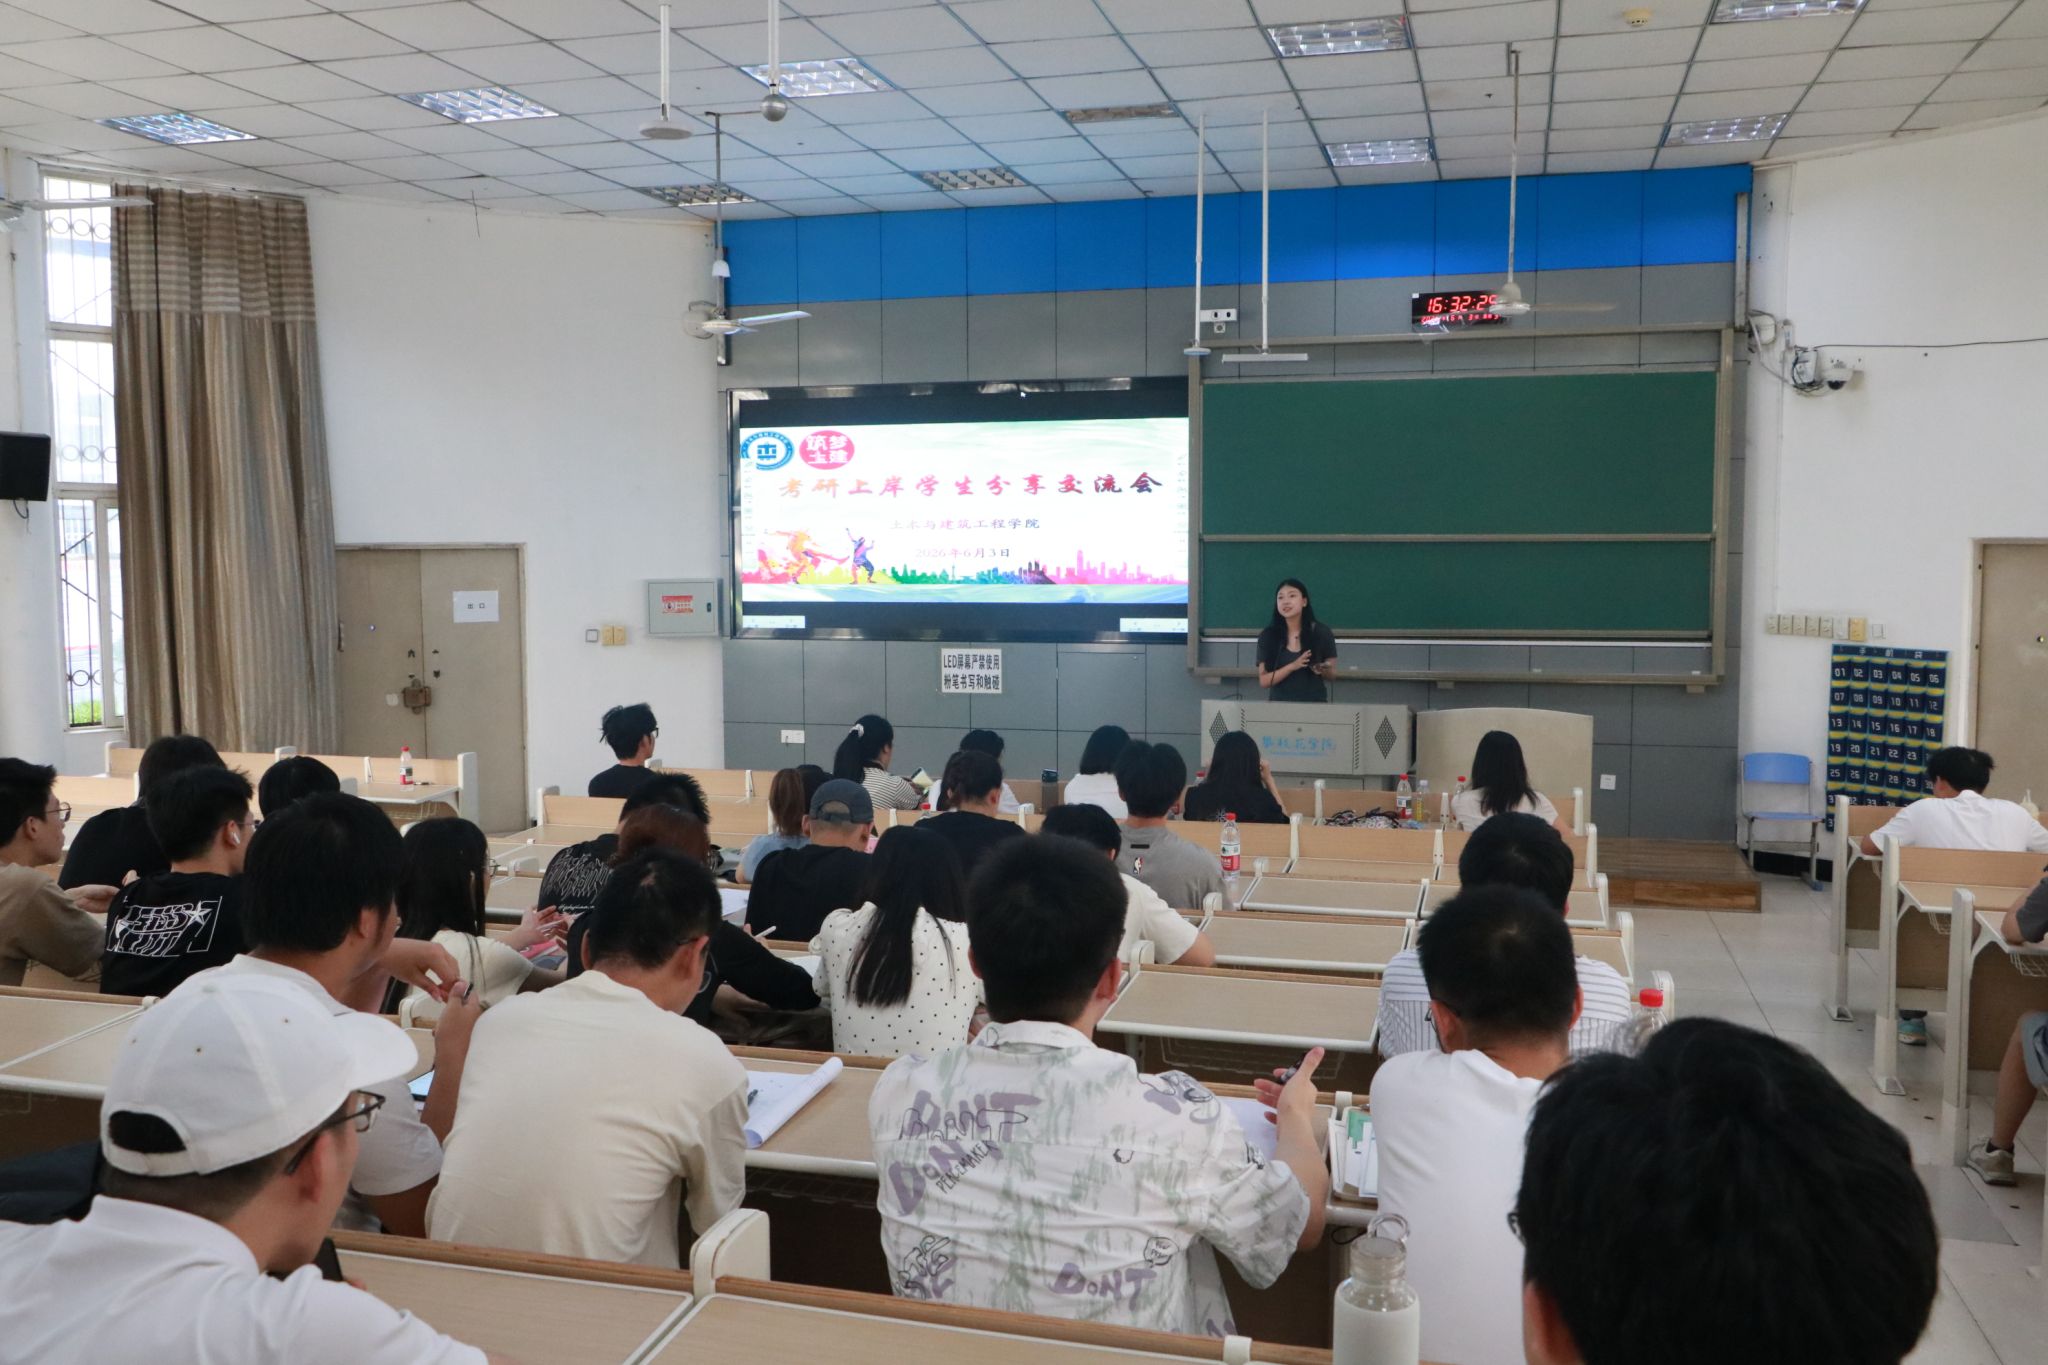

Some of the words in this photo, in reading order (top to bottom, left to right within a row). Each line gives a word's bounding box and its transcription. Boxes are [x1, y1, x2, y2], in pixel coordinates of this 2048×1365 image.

[779, 472, 1162, 499] 考研上岸学生分享交流会
[890, 518, 1040, 530] 土木与建筑工程学院
[915, 548, 1010, 558] 2026年6月3日
[943, 654, 1000, 670] LED屏幕严禁使用
[943, 673, 1000, 690] 粉笔书写和触碰
[1835, 668, 1846, 677] 01
[1854, 669, 1863, 677] 02
[1874, 670, 1883, 679] 03
[1892, 671, 1902, 680] 04
[1911, 673, 1920, 682] 05
[1929, 674, 1939, 683] 06
[1834, 693, 1845, 701] 07
[1854, 694, 1863, 702] 08
[1873, 696, 1882, 704] 09
[1891, 697, 1901, 706] 10
[1910, 699, 1919, 708] 11
[1929, 701, 1938, 710] 12
[1832, 718, 1842, 728] 13
[1853, 720, 1862, 729] 14
[1872, 722, 1881, 731] 15
[1890, 723, 1900, 733] 16
[1908, 725, 1917, 735] 17
[1927, 728, 1936, 737] 18
[1831, 744, 1841, 752] 19
[1850, 744, 1860, 753] 20
[1871, 747, 1880, 756] 21
[1889, 749, 1899, 758] 22
[1907, 751, 1917, 760] 23
[1830, 769, 1840, 778] 25
[1850, 770, 1860, 779] 26
[1869, 772, 1879, 781] 27
[1889, 775, 1899, 784] 28
[1907, 778, 1916, 787] 29
